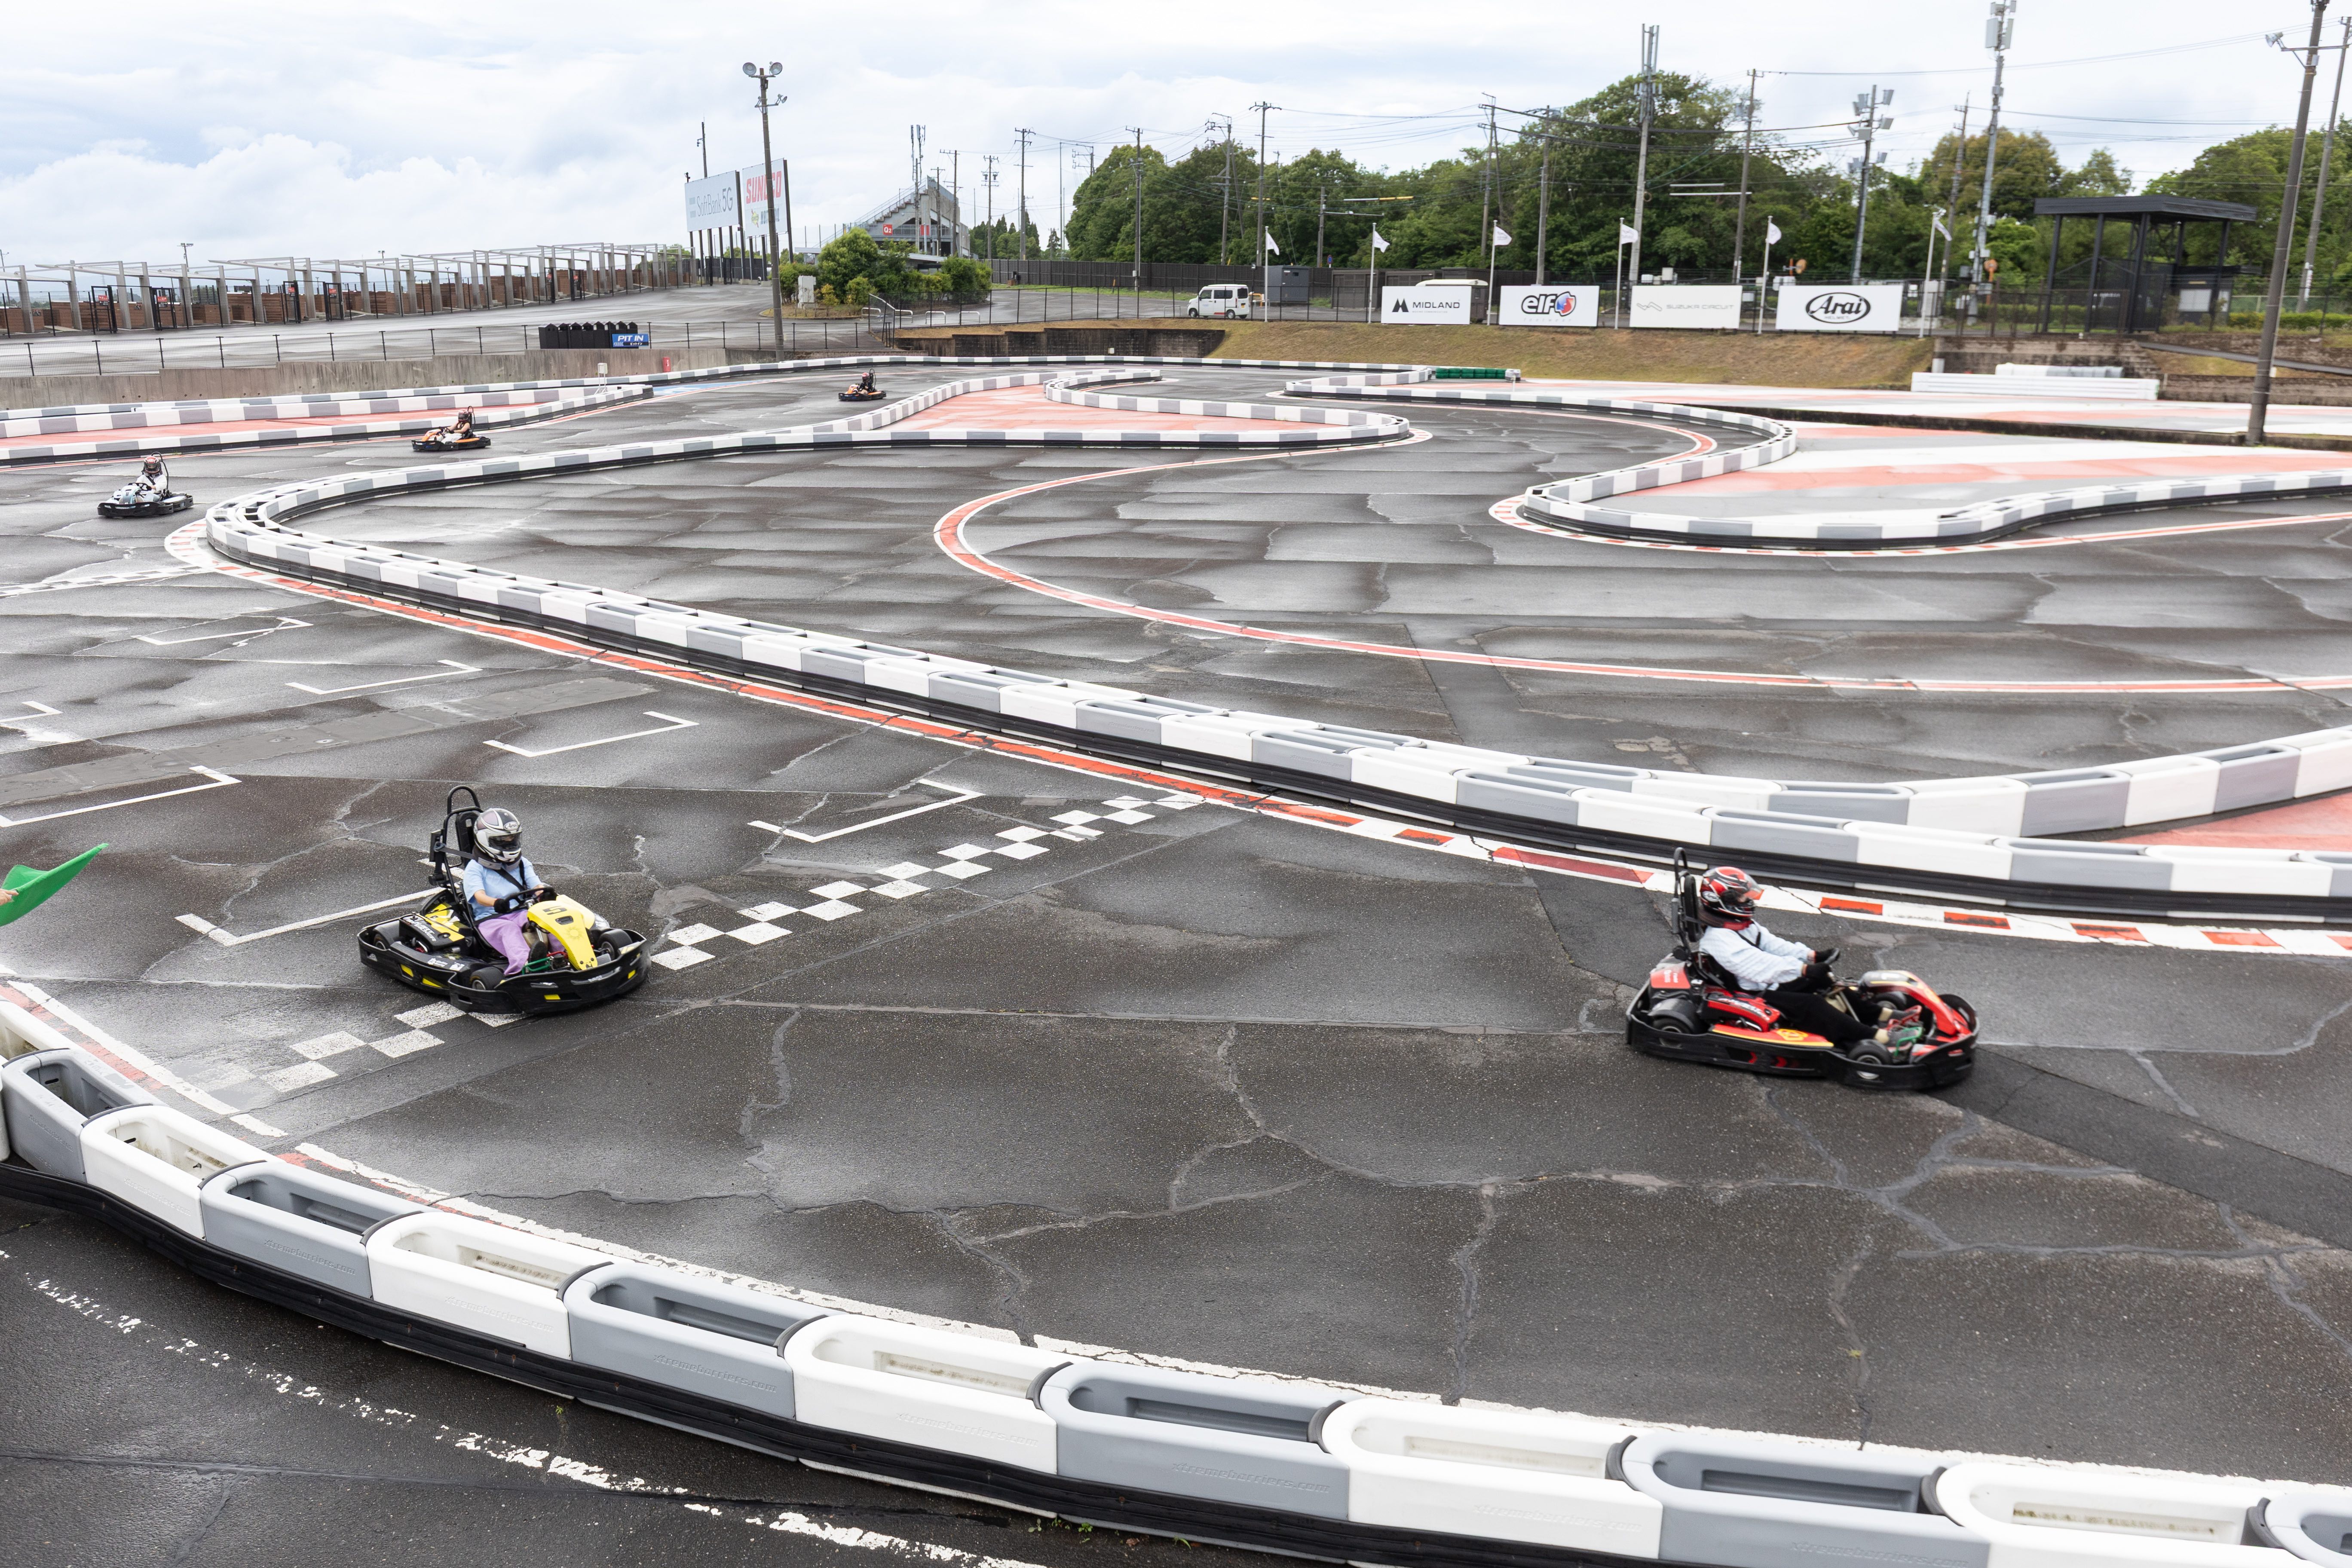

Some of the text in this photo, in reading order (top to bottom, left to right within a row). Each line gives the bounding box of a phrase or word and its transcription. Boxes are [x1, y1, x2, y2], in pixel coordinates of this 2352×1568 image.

[697, 187, 733, 216] SoftBank 5G
[1522, 294, 1557, 314] elf
[1808, 296, 1864, 315] Arai
[263, 1239, 356, 1276] xtremebarriers.com
[444, 1296, 554, 1333] xtremebarriers.com
[653, 1354, 778, 1393] xtremebarriers.com
[894, 1413, 1039, 1448] xtremebarriers.com
[1171, 1462, 1330, 1493] xtremebarriers.com
